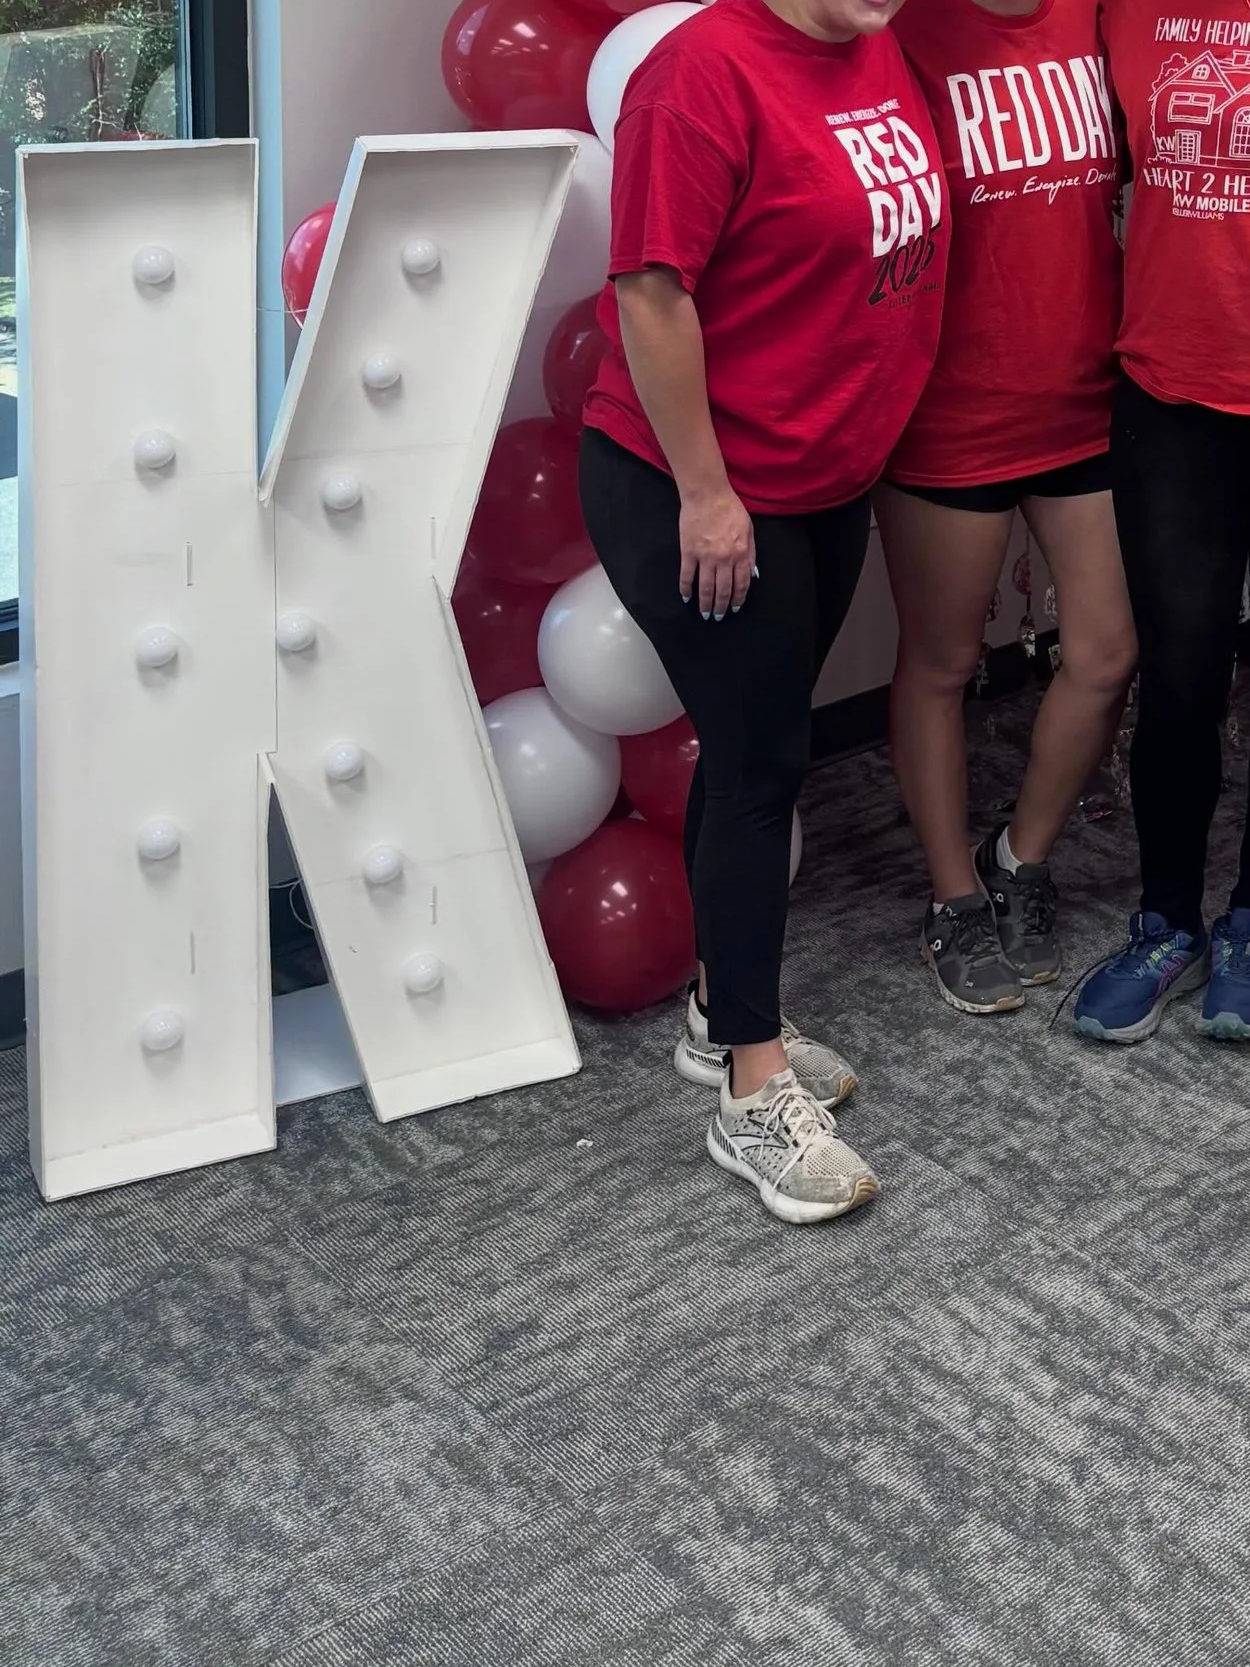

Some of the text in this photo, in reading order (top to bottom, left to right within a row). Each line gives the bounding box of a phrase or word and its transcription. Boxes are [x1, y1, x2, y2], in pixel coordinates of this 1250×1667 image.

[1154, 17, 1202, 43] FAMILY
[946, 55, 1117, 179] RED DAY
[832, 116, 931, 189] RED
[970, 184, 1018, 205] Renew.
[1143, 167, 1195, 192] HEART
[1200, 172, 1216, 194] 2
[867, 172, 942, 258] DAY
